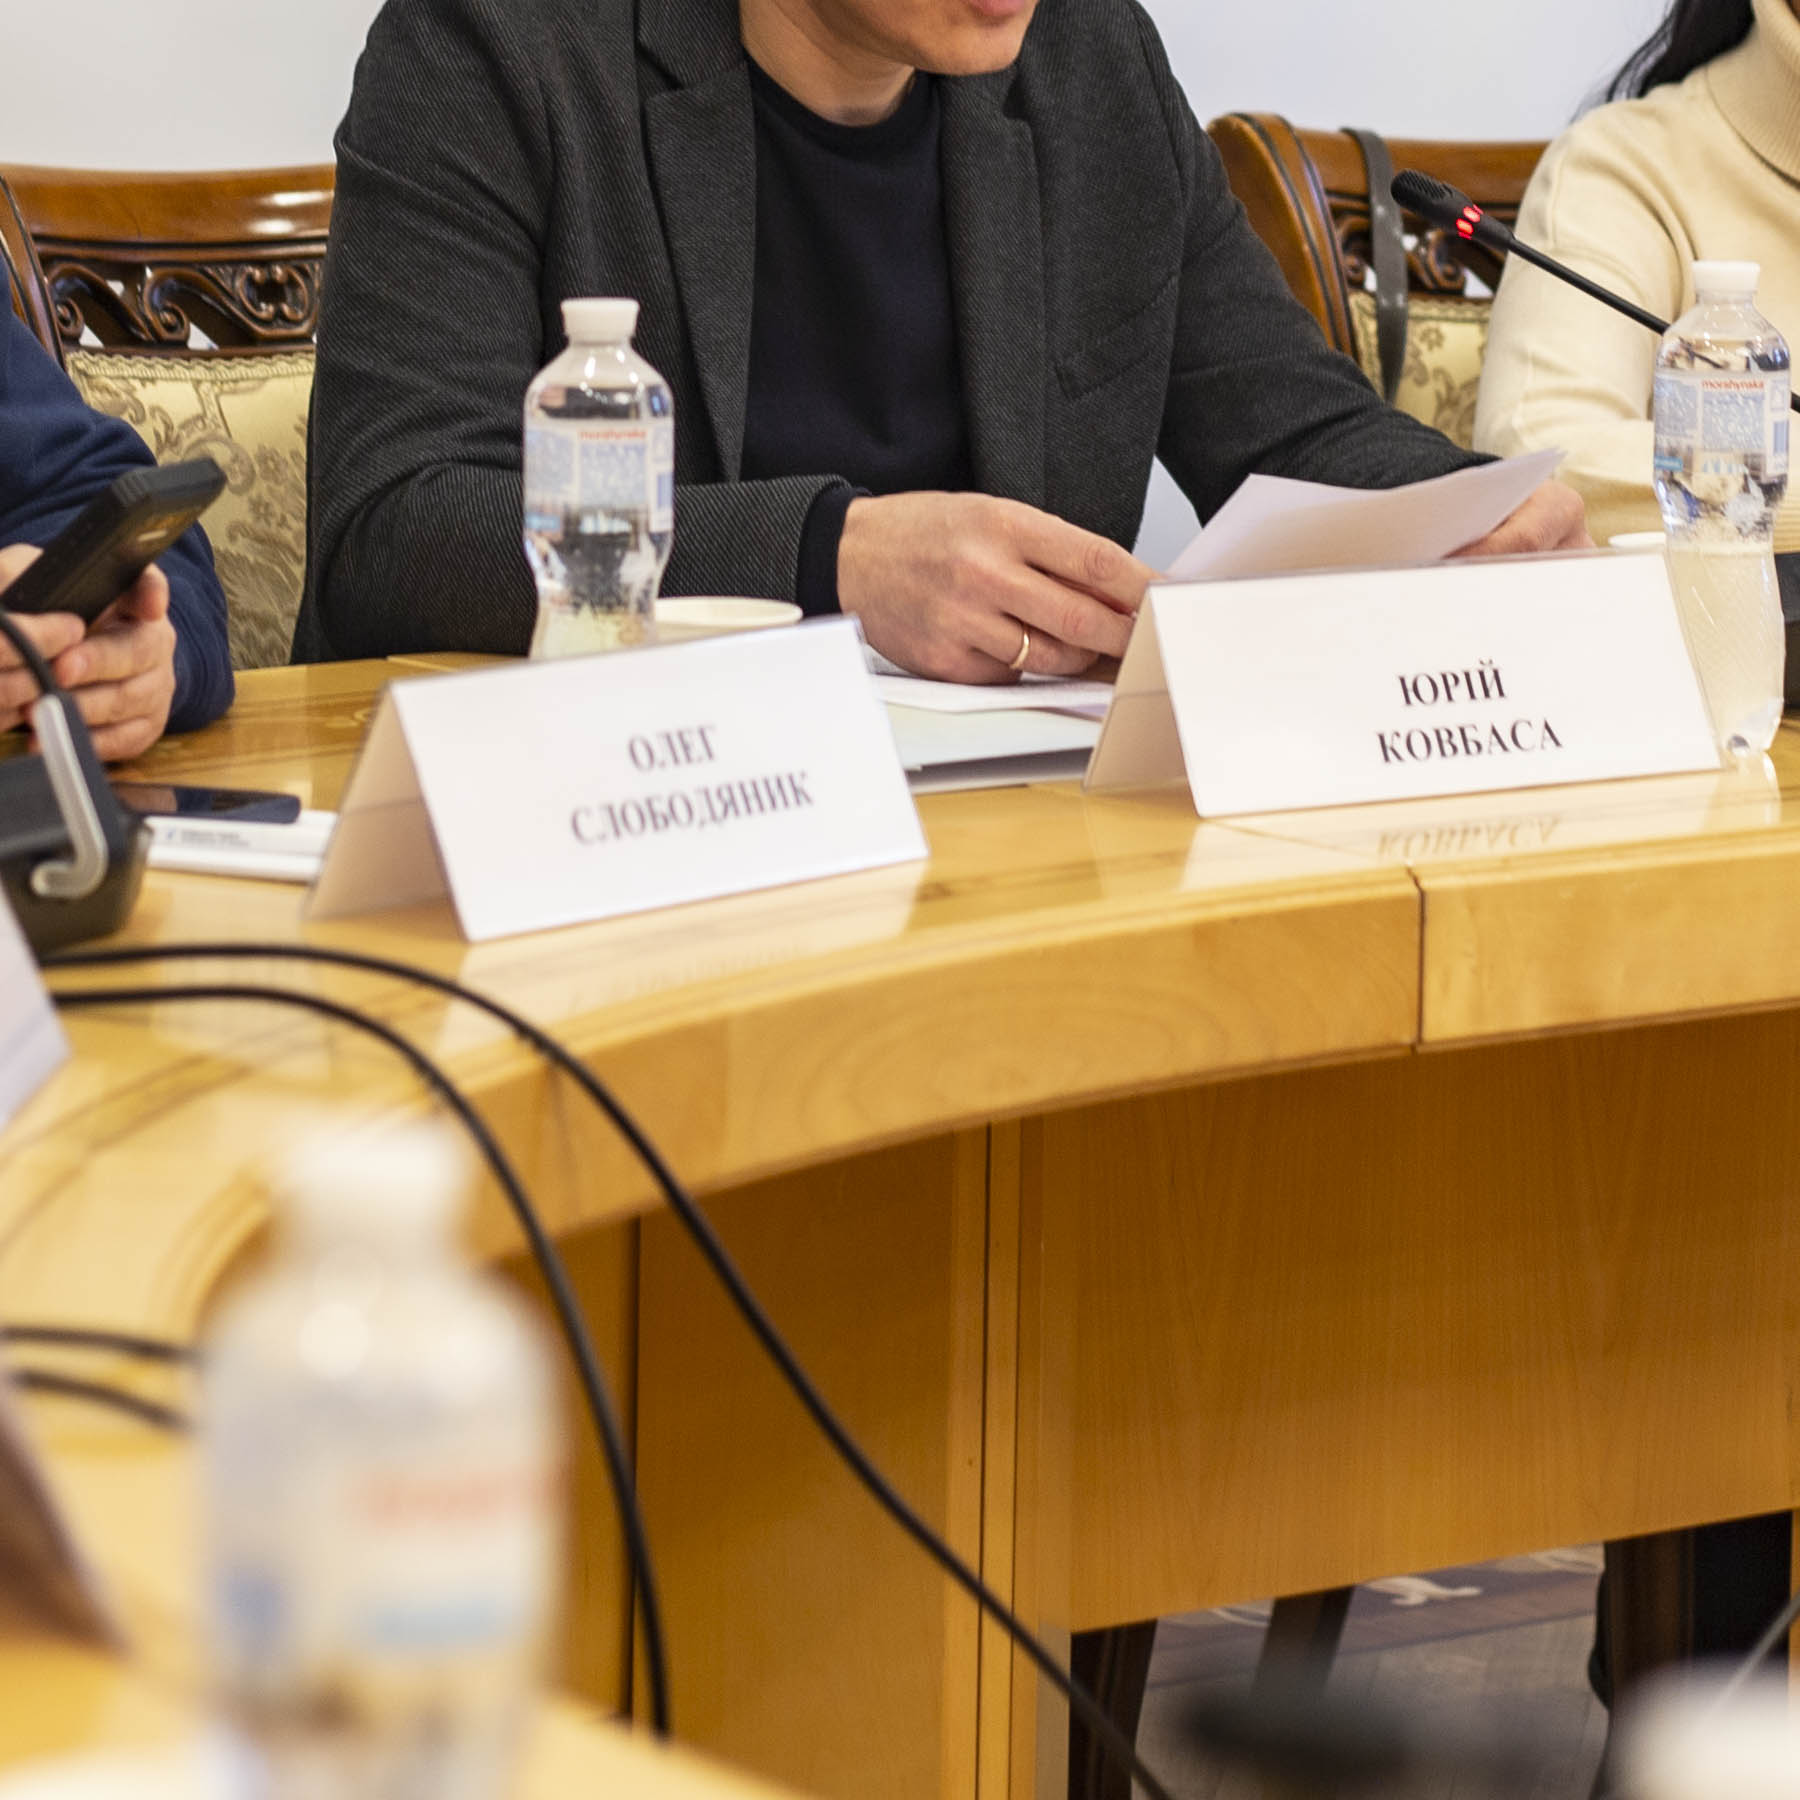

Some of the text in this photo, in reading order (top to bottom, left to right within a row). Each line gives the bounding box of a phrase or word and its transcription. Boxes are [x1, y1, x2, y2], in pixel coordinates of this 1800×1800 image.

[1397, 658, 1508, 708] ЮРІЙ
[627, 726, 715, 770] ОЛЕГ
[1376, 719, 1563, 764] КОВБАСА
[569, 771, 813, 843] СЛОБОДЯНИК
